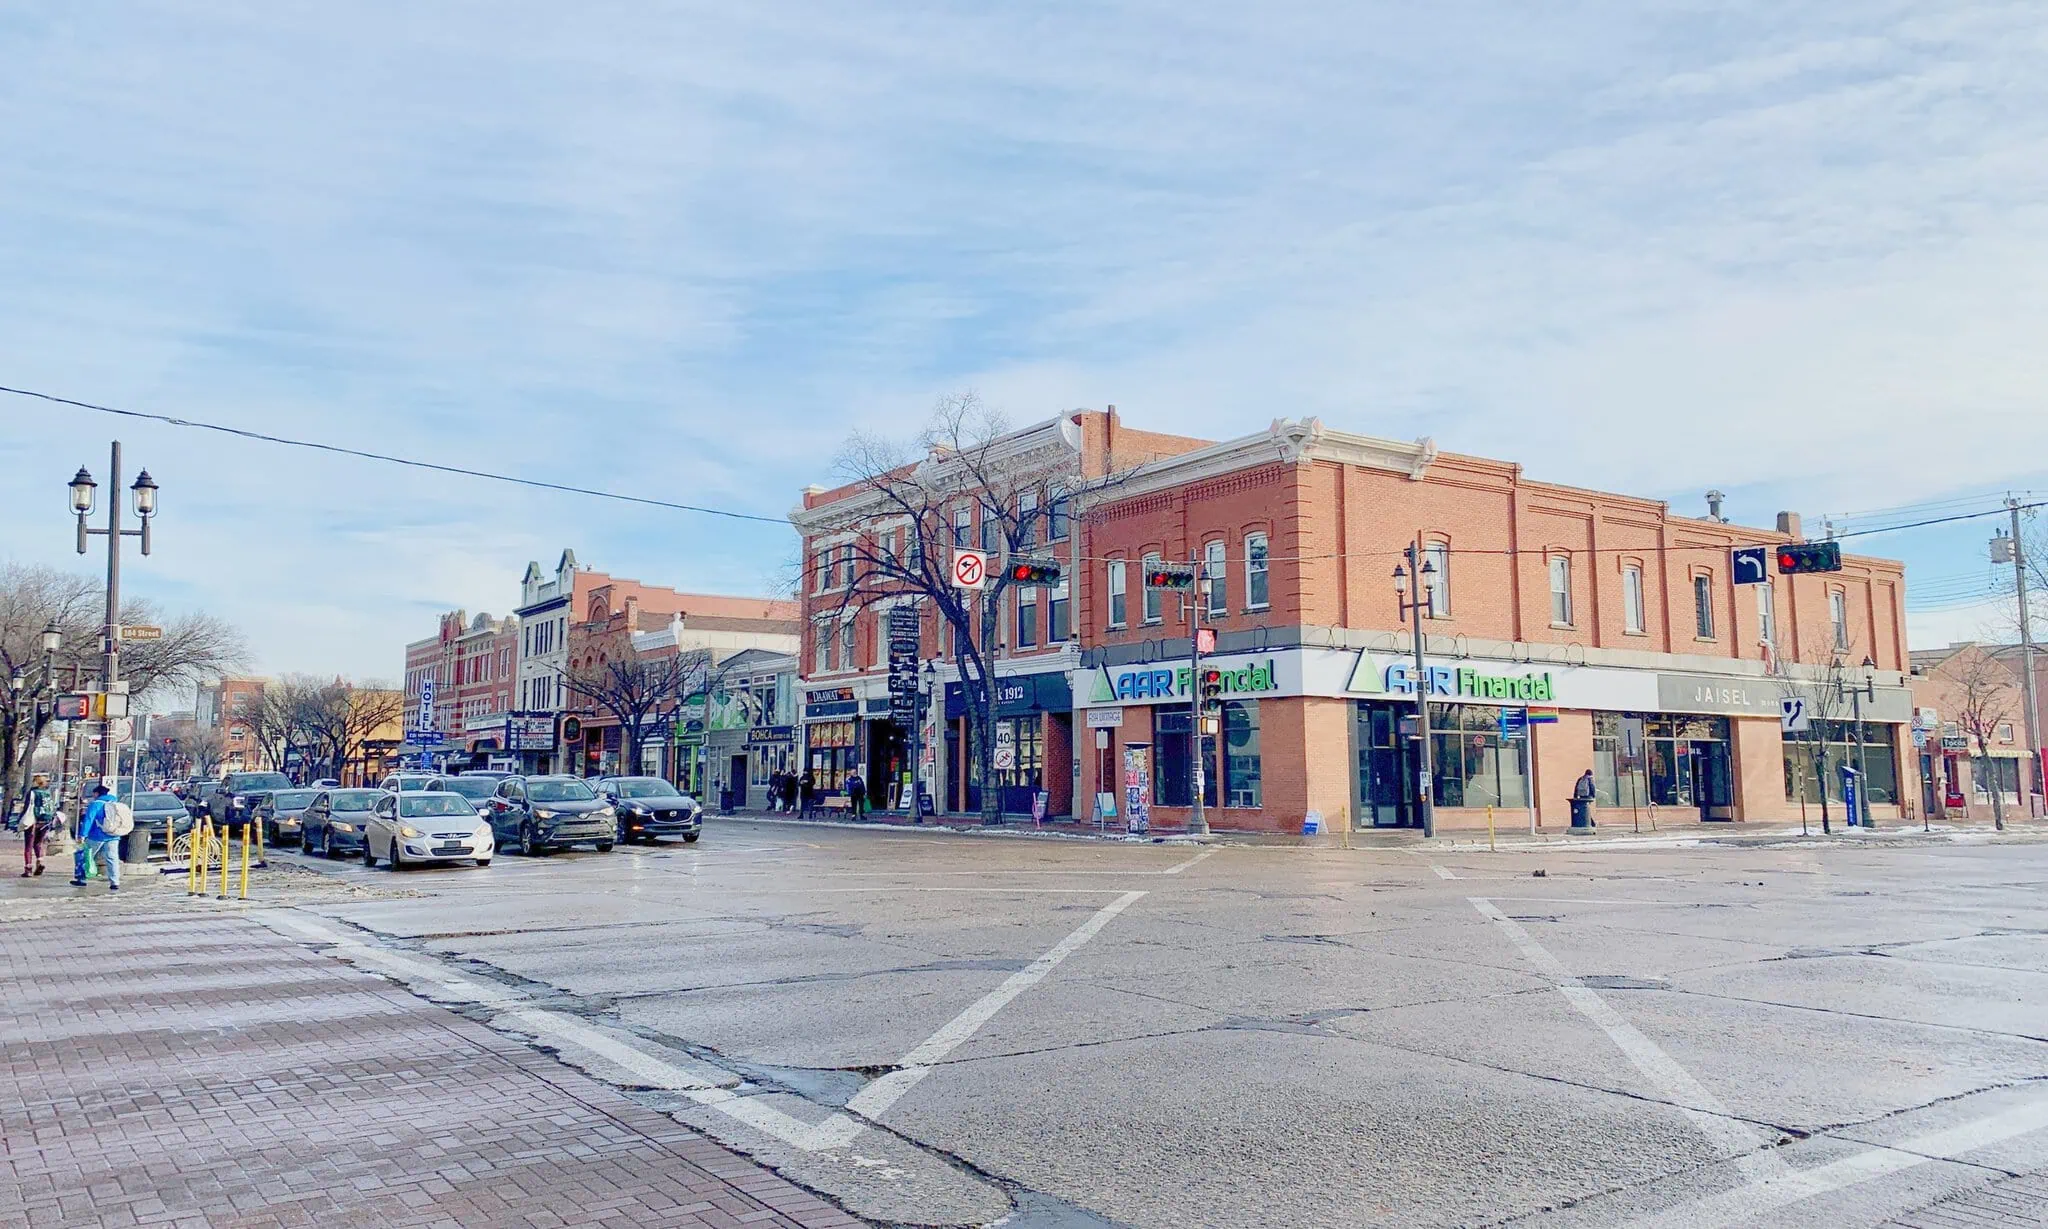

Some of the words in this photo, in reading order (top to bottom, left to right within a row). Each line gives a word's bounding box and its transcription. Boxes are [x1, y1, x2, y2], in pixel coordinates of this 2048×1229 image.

[138, 629, 160, 637] Street
[1118, 670, 1173, 700] AAR
[1177, 659, 1277, 694] Fincial
[1457, 667, 1555, 700] Financial
[1004, 686, 1024, 700] 1912
[1695, 686, 1751, 706] JAISEL
[422, 683, 432, 730] HOTEL
[997, 732, 1011, 744] 40
